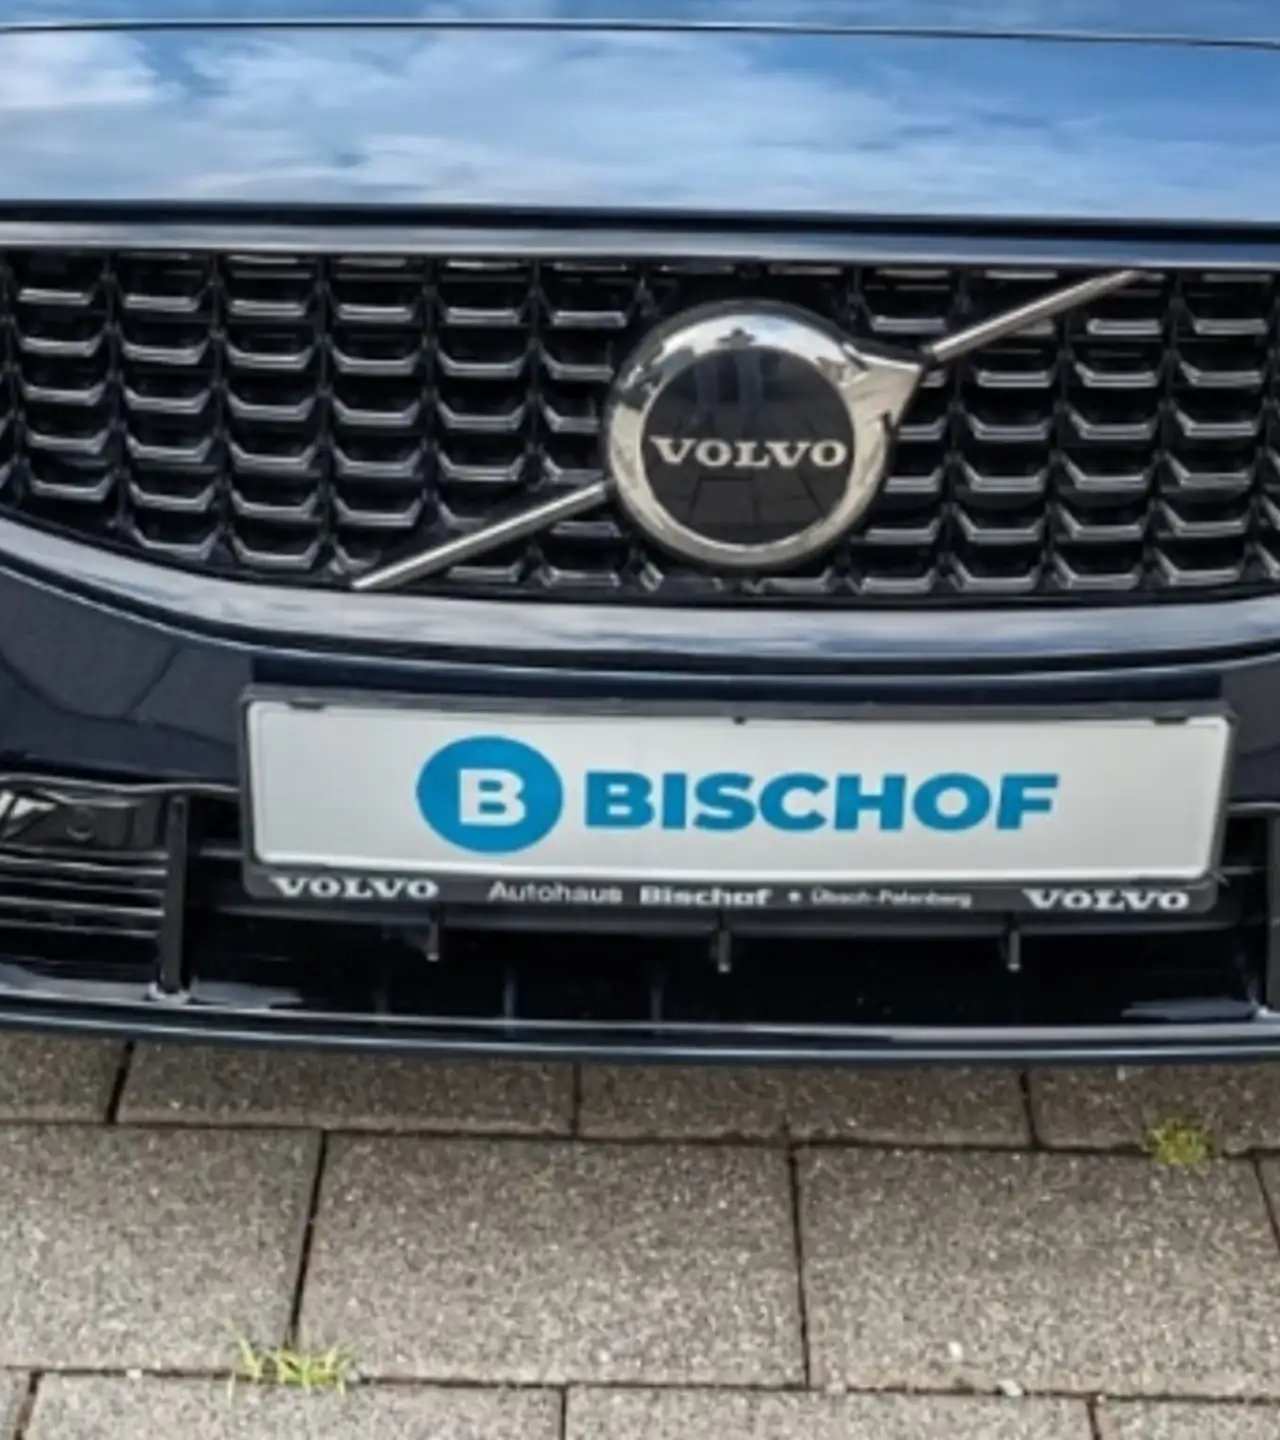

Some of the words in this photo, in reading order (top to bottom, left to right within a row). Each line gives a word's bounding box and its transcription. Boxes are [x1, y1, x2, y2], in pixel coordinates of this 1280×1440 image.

[649, 434, 848, 468] VOLVO
[458, 767, 526, 827] B
[584, 770, 1060, 832] BISCHOF
[269, 875, 440, 901] VOLVO
[487, 879, 624, 904] Autohaus
[639, 885, 771, 907] Bischof
[1022, 887, 1190, 911] VOLVO
